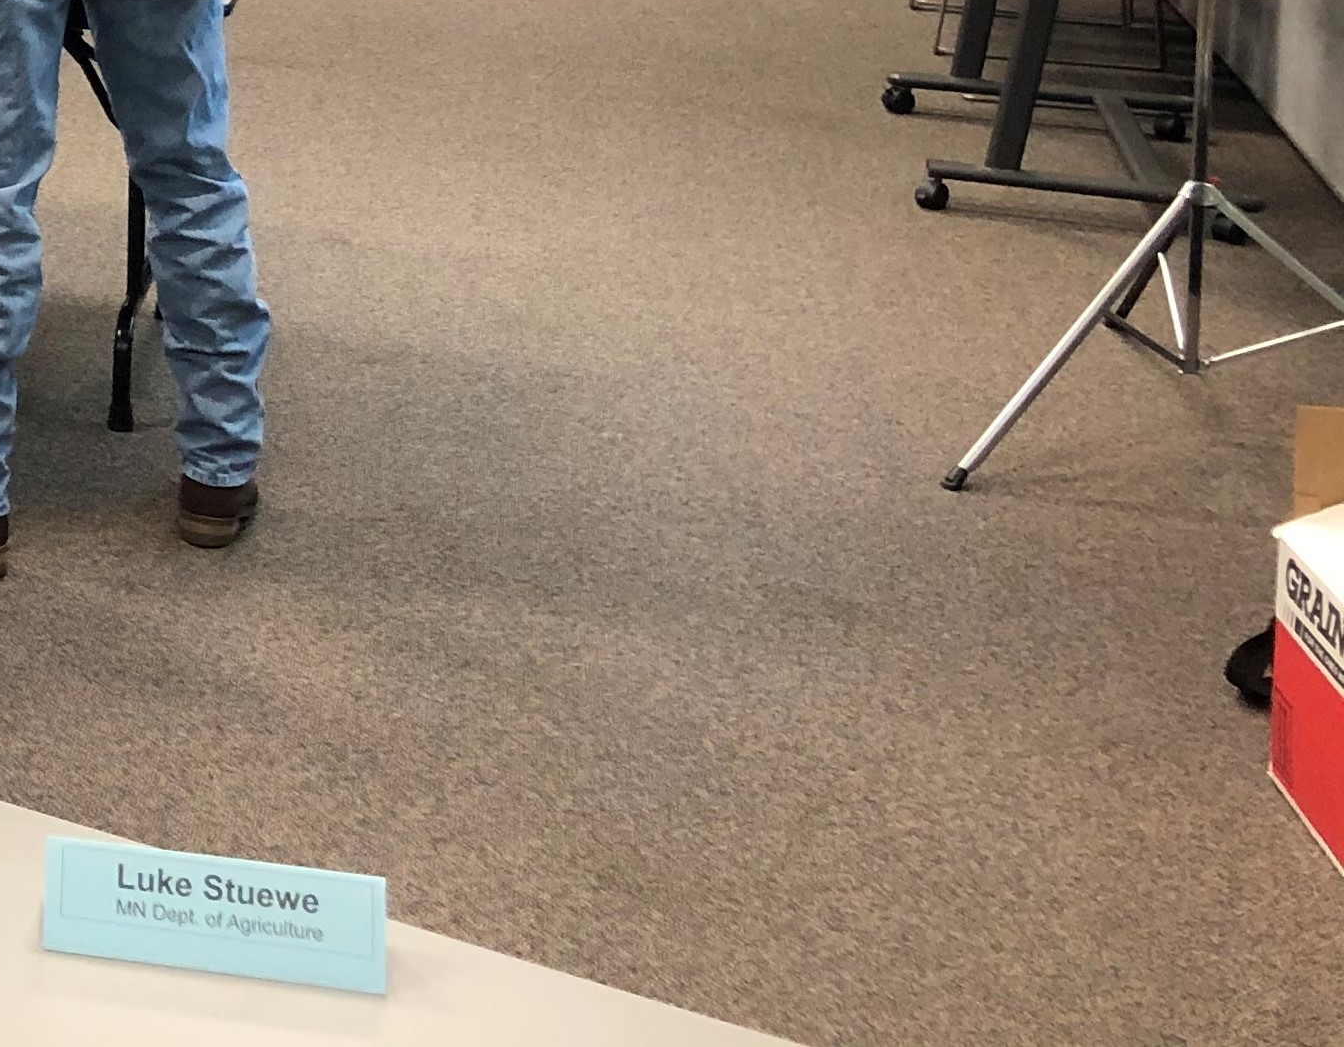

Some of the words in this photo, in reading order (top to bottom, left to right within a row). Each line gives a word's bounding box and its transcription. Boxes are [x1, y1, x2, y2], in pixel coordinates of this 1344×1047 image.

[116, 862, 193, 898] Luke
[203, 873, 320, 915] Stuewe
[115, 898, 147, 919] MN
[152, 902, 199, 927] Dept.
[204, 912, 223, 928] of
[225, 913, 325, 943] Agriculture
